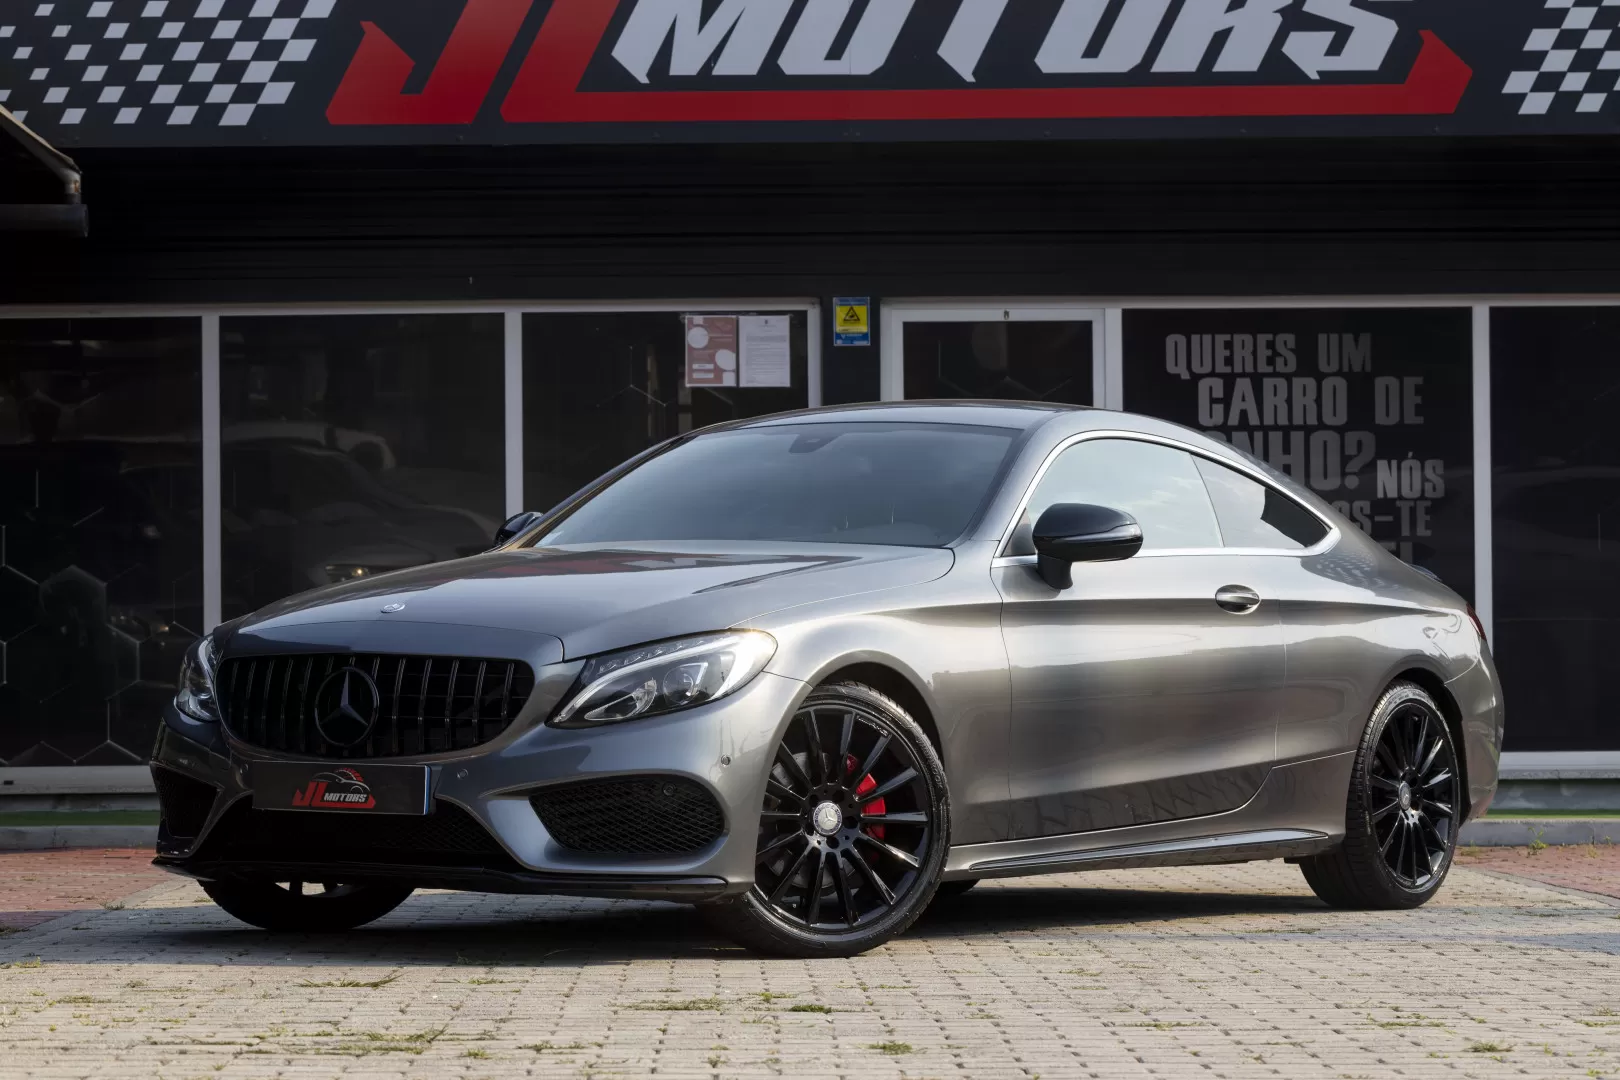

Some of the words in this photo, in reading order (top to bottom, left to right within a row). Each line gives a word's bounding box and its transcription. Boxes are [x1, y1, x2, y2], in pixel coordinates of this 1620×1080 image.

[1165, 333, 1297, 379] QUERES
[1317, 333, 1372, 373] UM
[1198, 376, 1349, 427] CARRO
[1374, 376, 1424, 425] DE
[1203, 430, 1376, 491] HO?
[1376, 452, 1445, 499] NÓS
[324, 792, 367, 802] MOTORS
